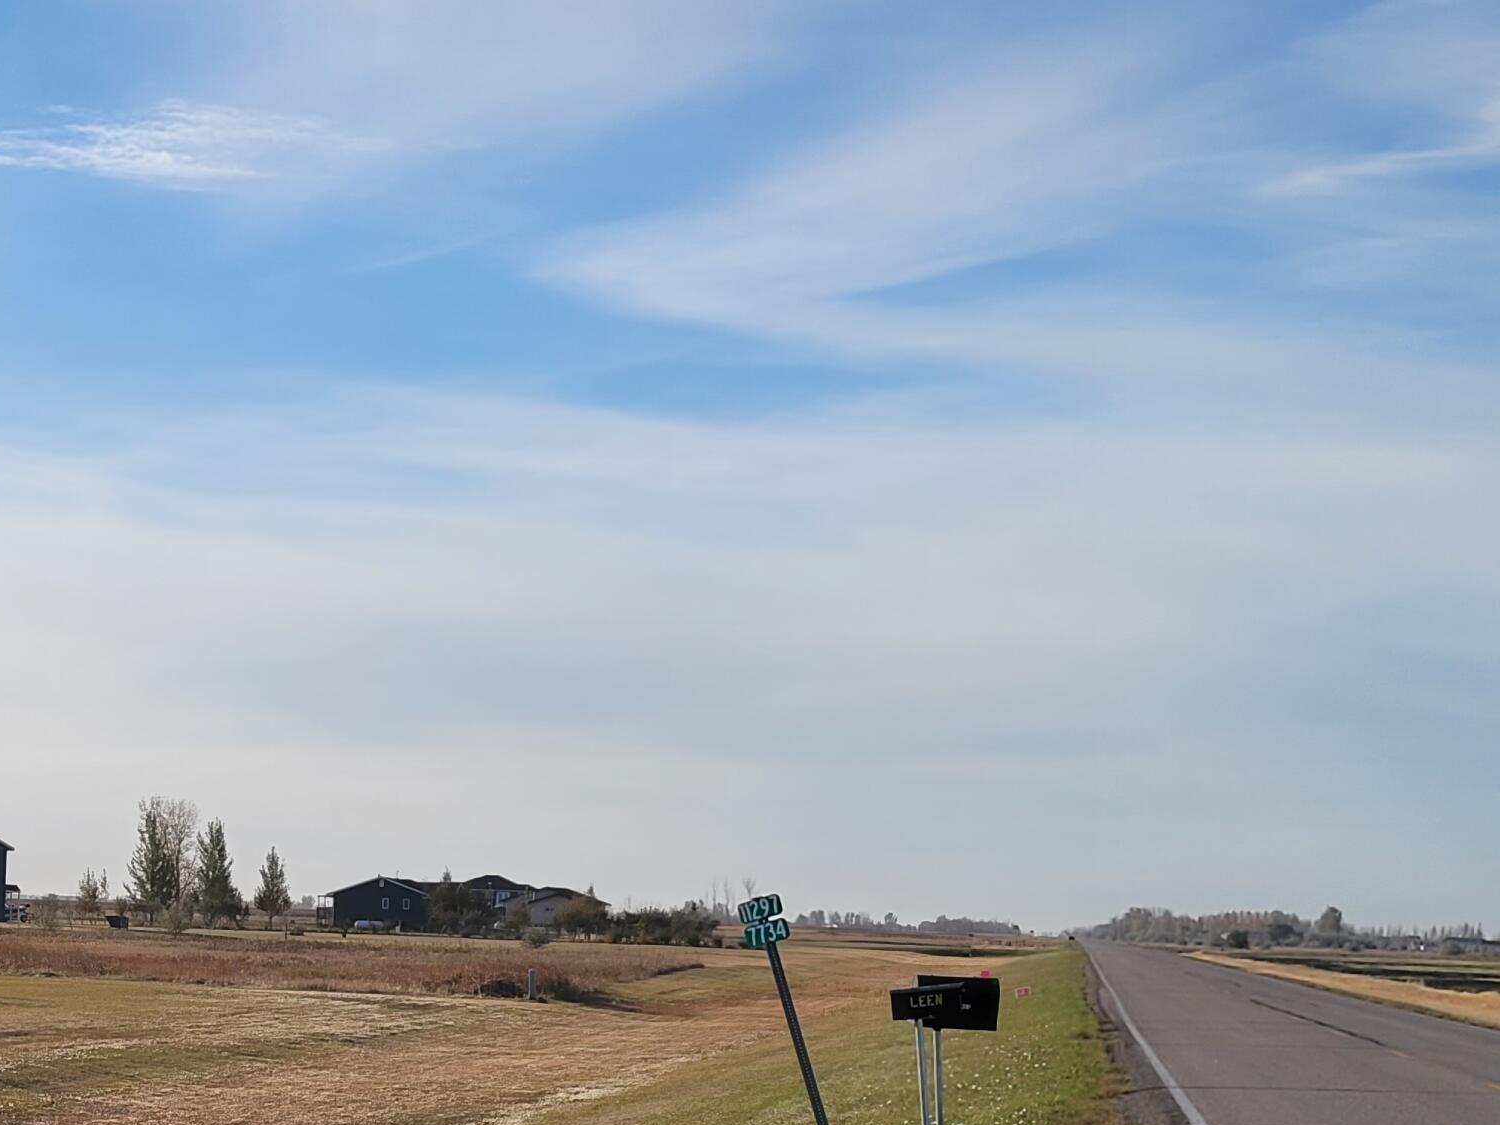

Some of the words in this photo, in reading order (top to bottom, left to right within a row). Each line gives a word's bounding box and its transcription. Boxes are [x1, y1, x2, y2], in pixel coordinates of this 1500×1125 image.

[740, 895, 778, 923] 11297
[747, 920, 787, 946] 7734
[910, 993, 943, 1008] LEEN
